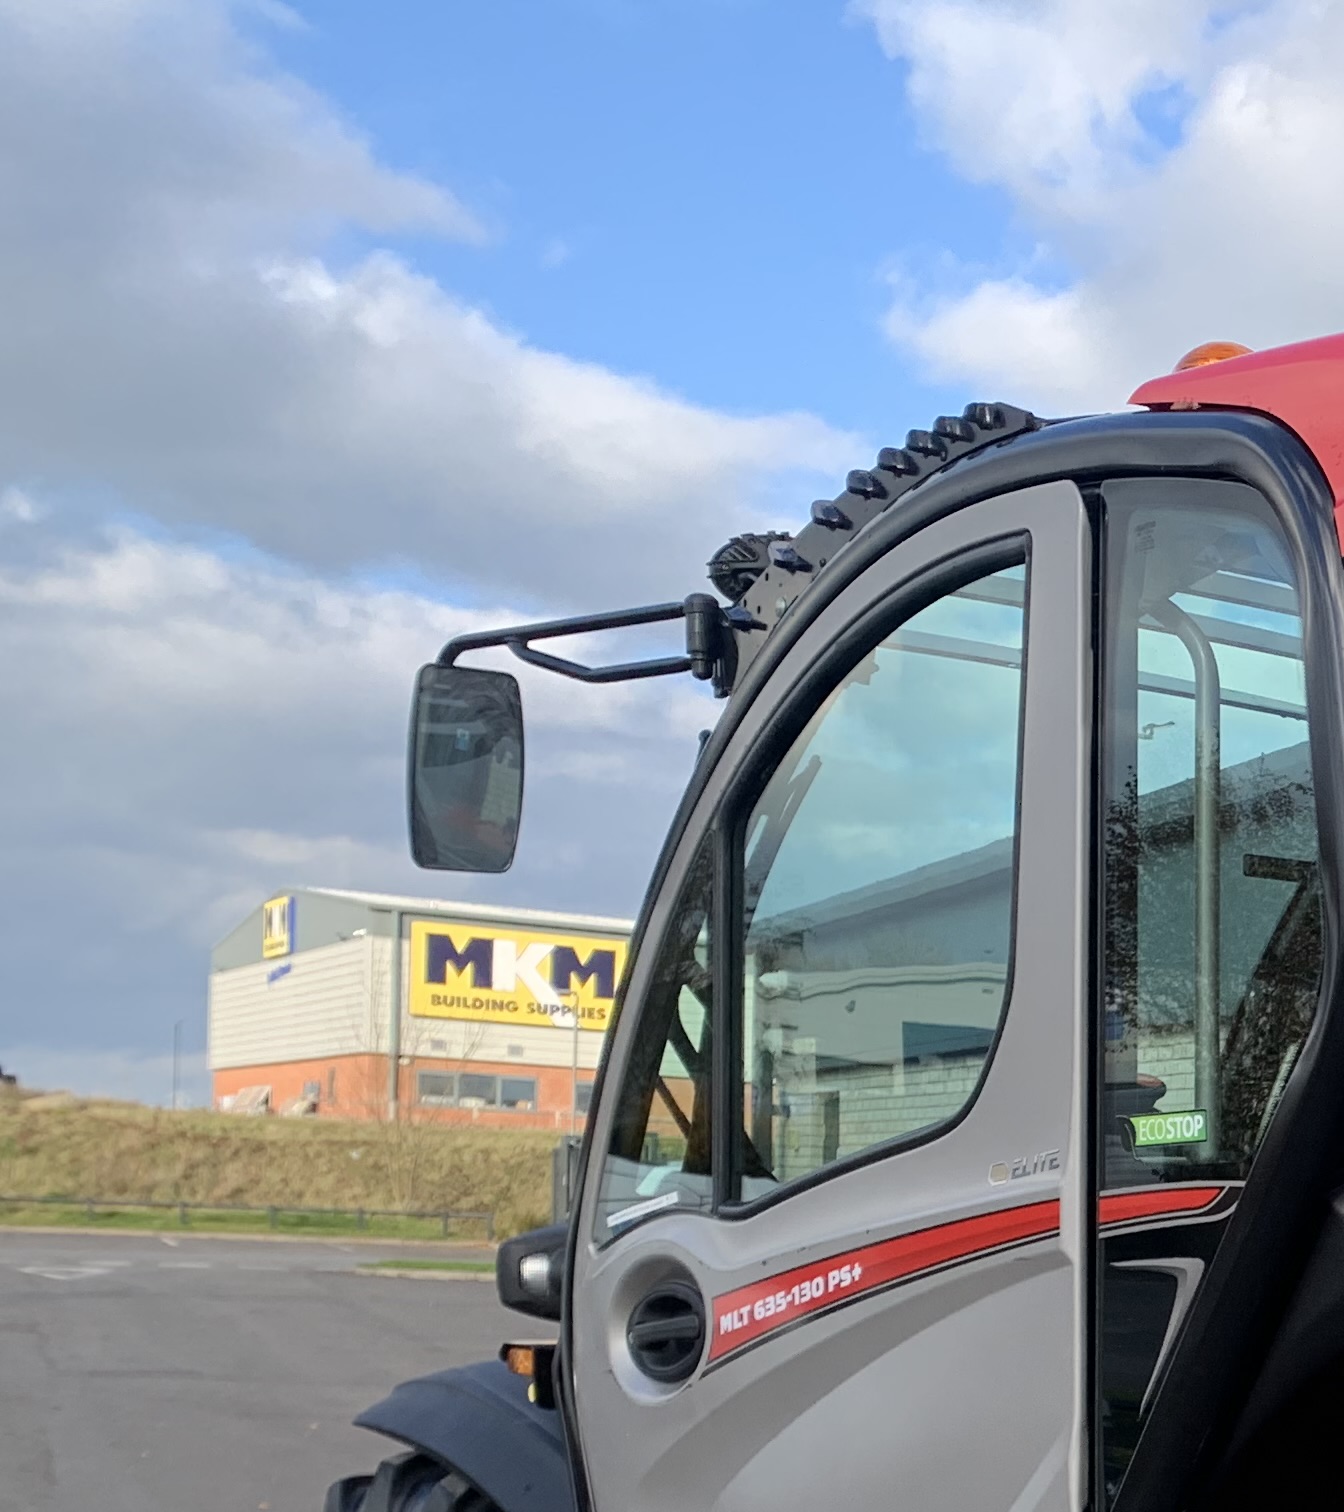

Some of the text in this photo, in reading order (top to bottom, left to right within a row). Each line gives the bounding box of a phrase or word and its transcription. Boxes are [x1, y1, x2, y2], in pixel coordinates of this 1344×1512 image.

[425, 932, 617, 1020] MKM
[430, 993, 520, 1013] BUILDING
[1138, 1114, 1204, 1142] ECOSTOP
[1010, 1148, 1061, 1180] ELITE
[719, 1262, 863, 1336] MLT 635-130 PS+
